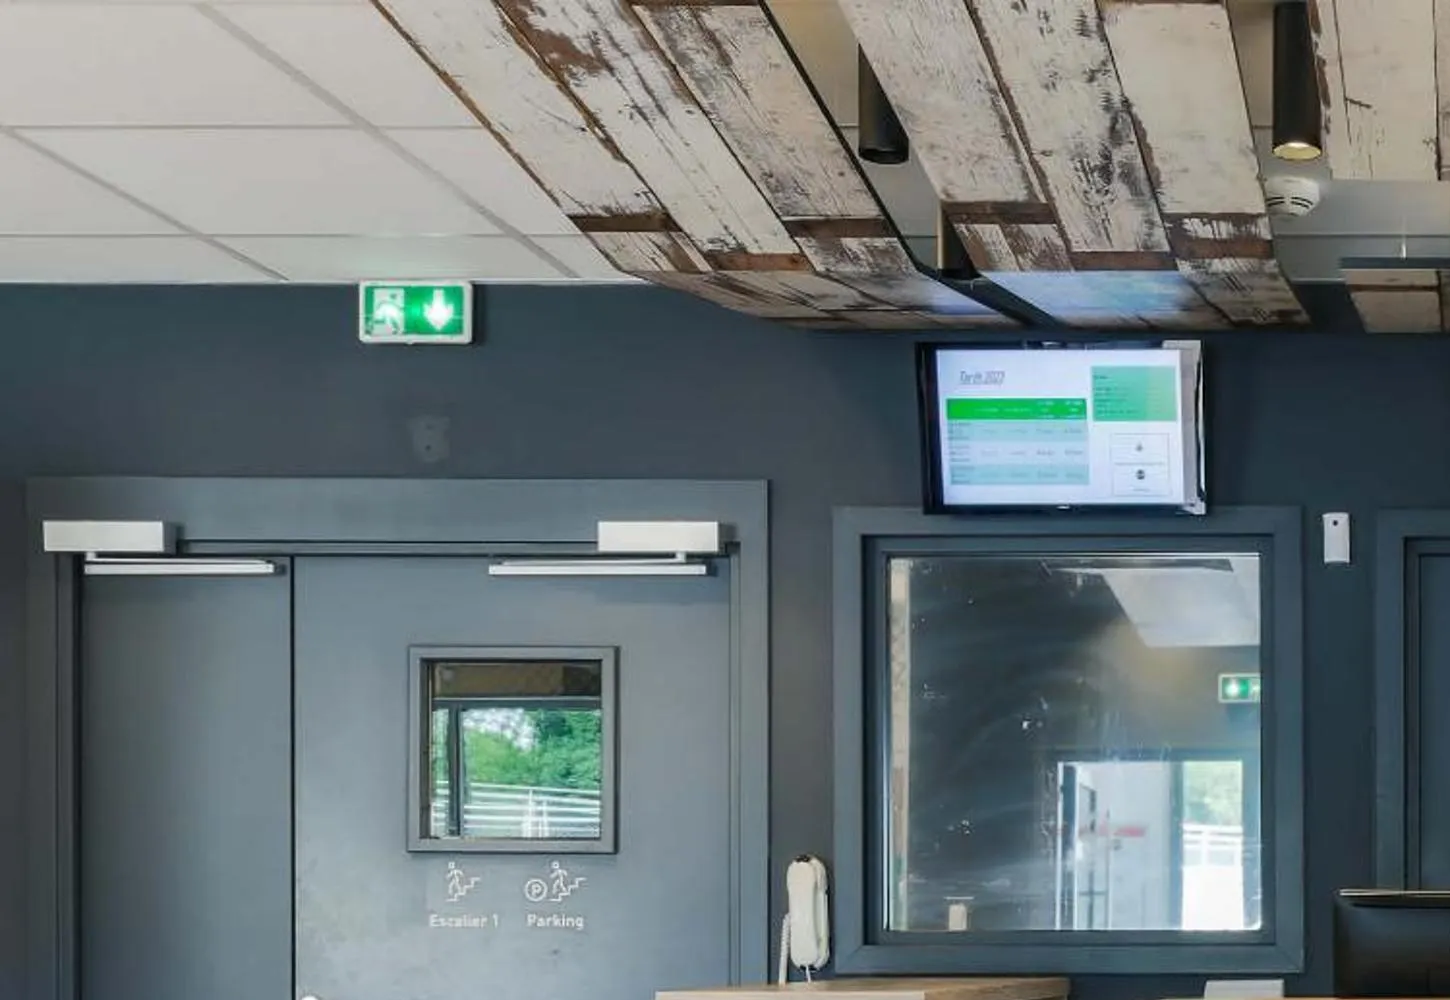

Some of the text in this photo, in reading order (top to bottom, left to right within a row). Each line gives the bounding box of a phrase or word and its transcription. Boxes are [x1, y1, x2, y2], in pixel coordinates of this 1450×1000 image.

[429, 912, 499, 928] Escalier 1
[526, 913, 585, 931] Parking
